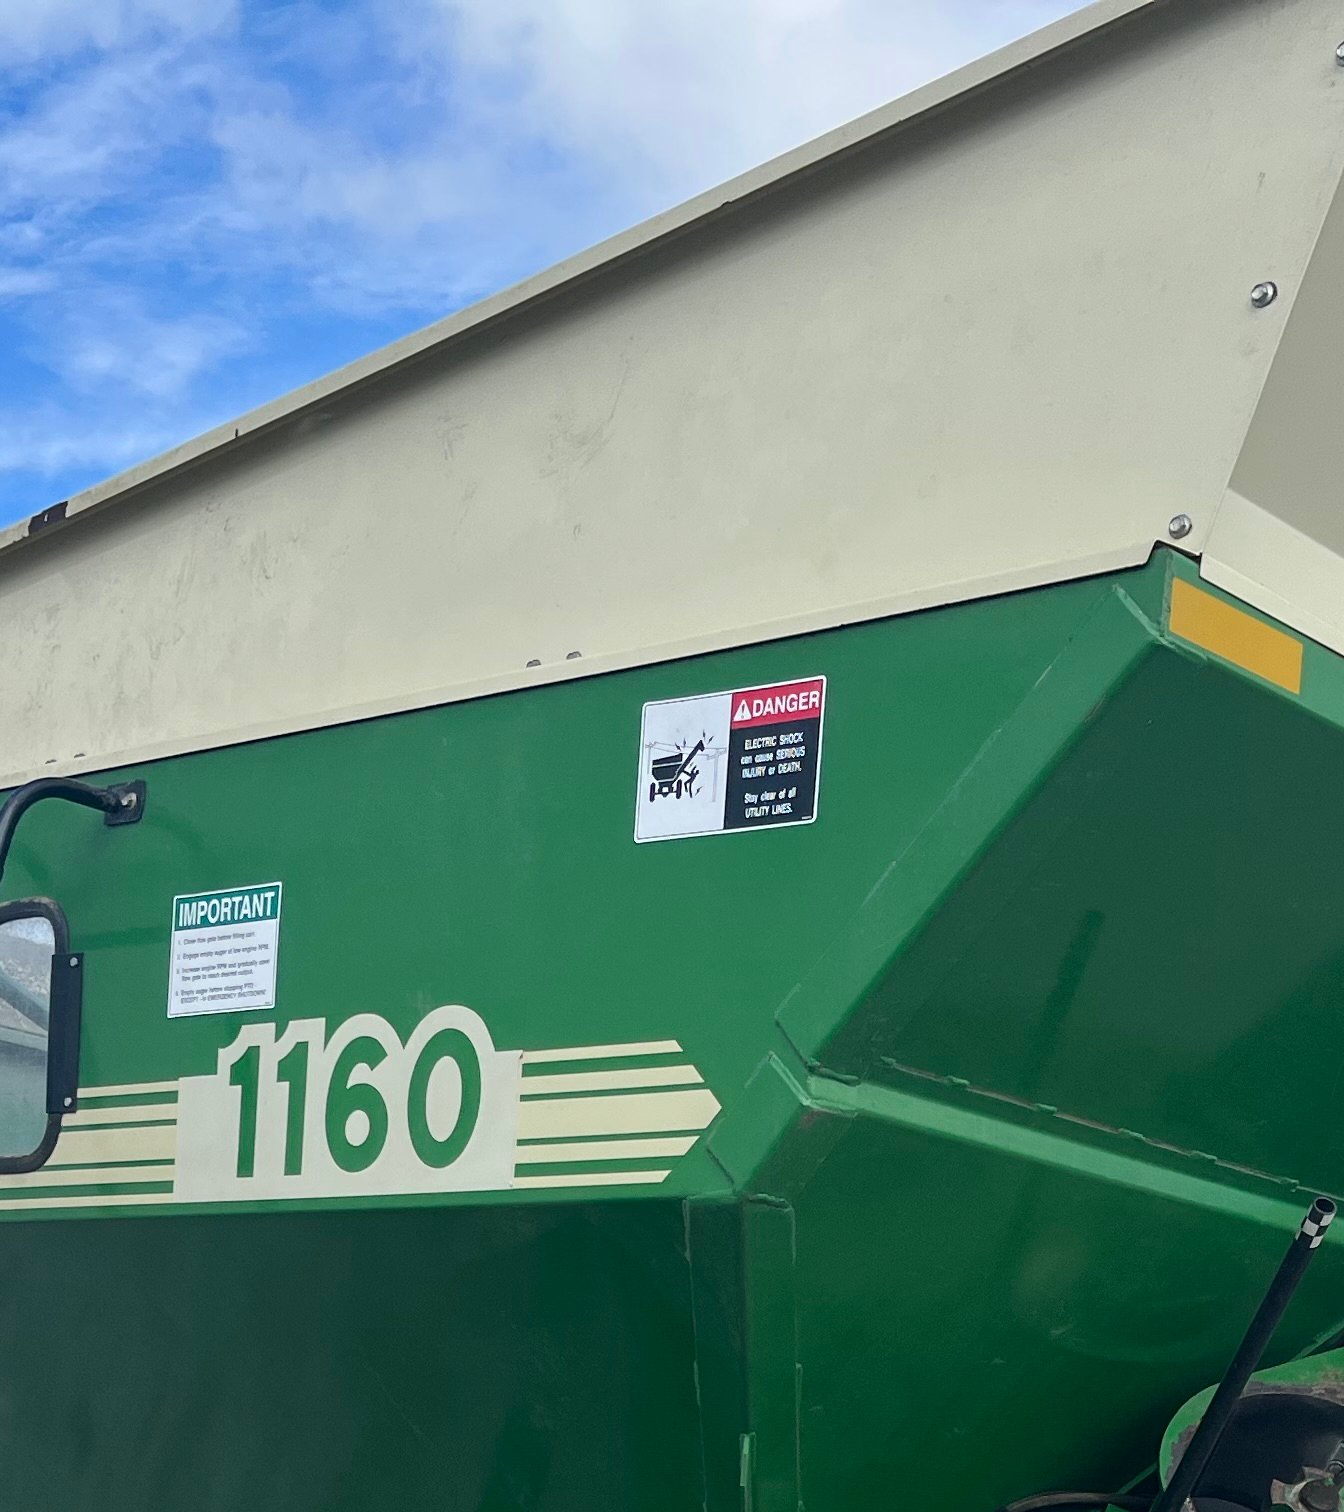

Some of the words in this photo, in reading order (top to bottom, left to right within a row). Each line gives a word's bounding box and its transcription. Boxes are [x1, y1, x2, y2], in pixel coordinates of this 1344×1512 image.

[751, 690, 820, 717] DANGER
[745, 735, 777, 750] ELECTRIC
[779, 732, 804, 745] SHOCK
[178, 891, 276, 927] IMPORTANT
[229, 1027, 482, 1178] 1160
